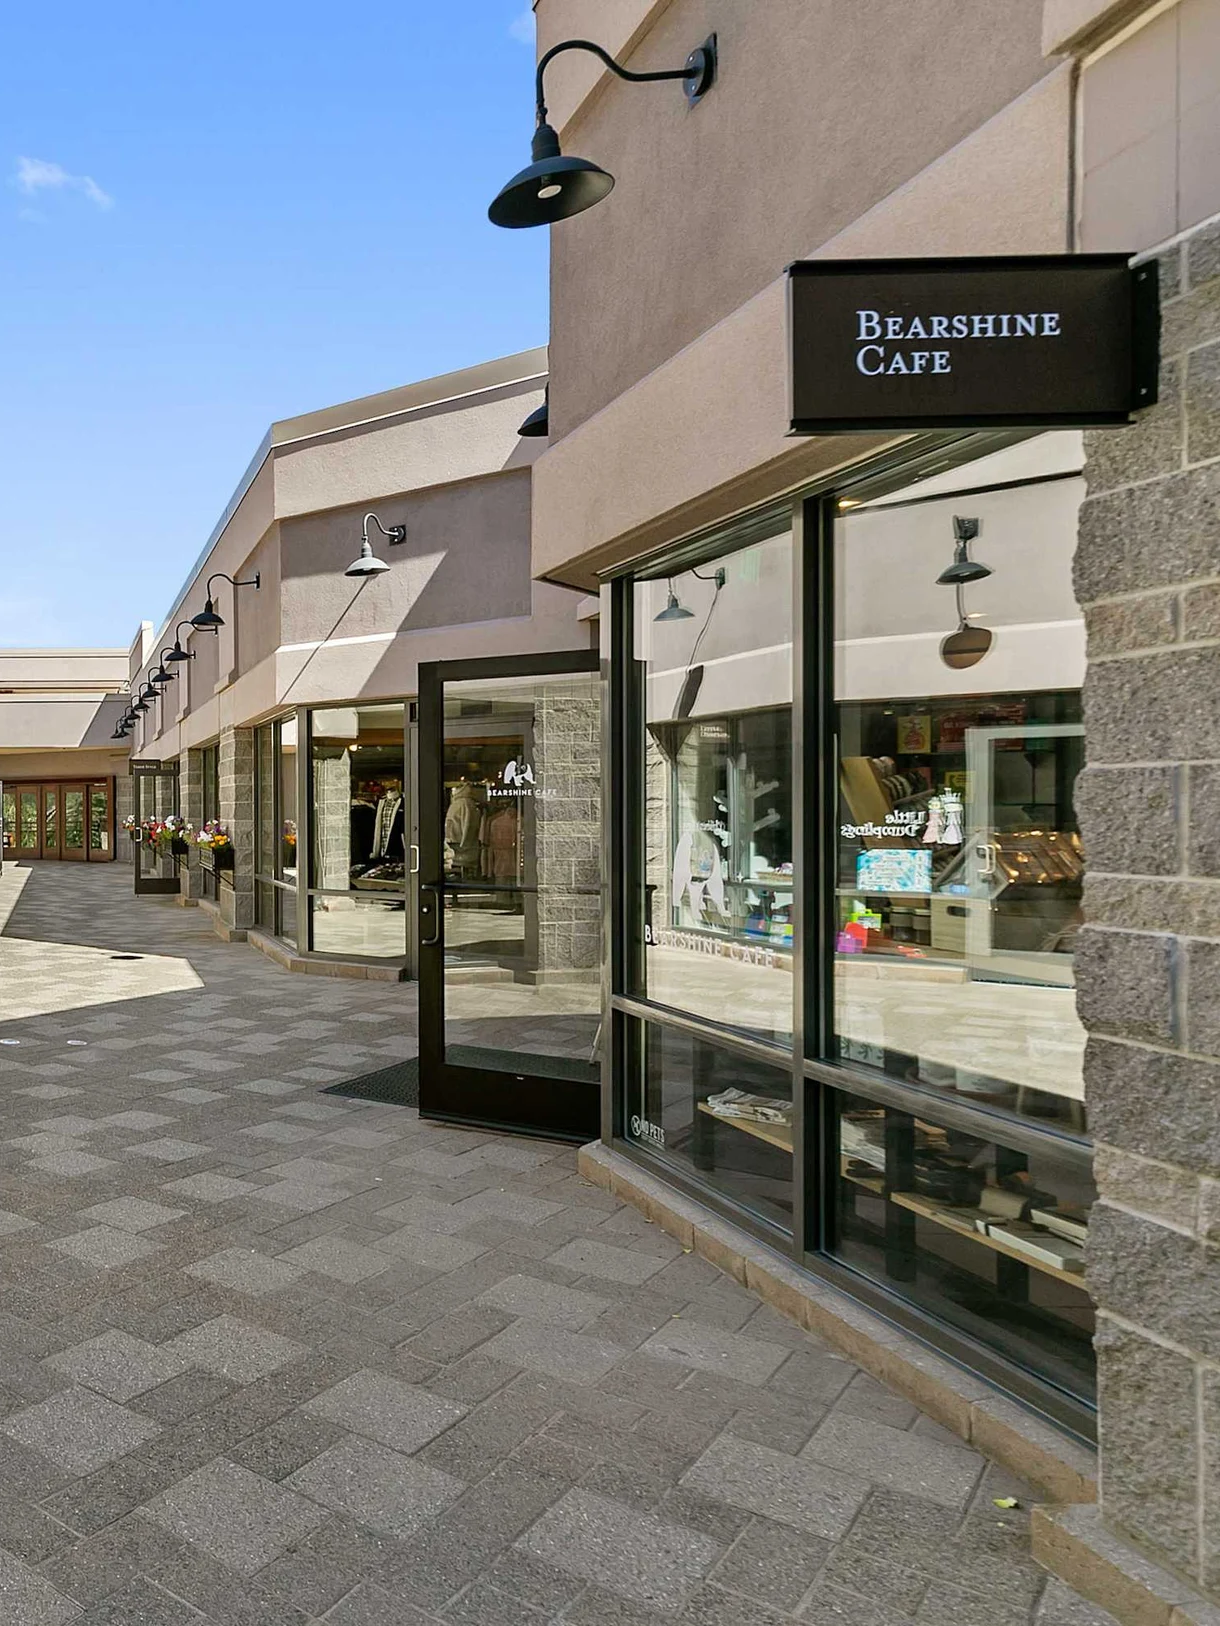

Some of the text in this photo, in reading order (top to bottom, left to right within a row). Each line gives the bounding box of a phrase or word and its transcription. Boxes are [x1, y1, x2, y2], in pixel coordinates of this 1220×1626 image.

[855, 309, 1061, 341] BEARSHINE
[855, 344, 952, 376] CAFE
[487, 789, 532, 797] BEARSHINE
[644, 924, 774, 968] BEARSHINE CAFE
[650, 1123, 665, 1143] PETS
